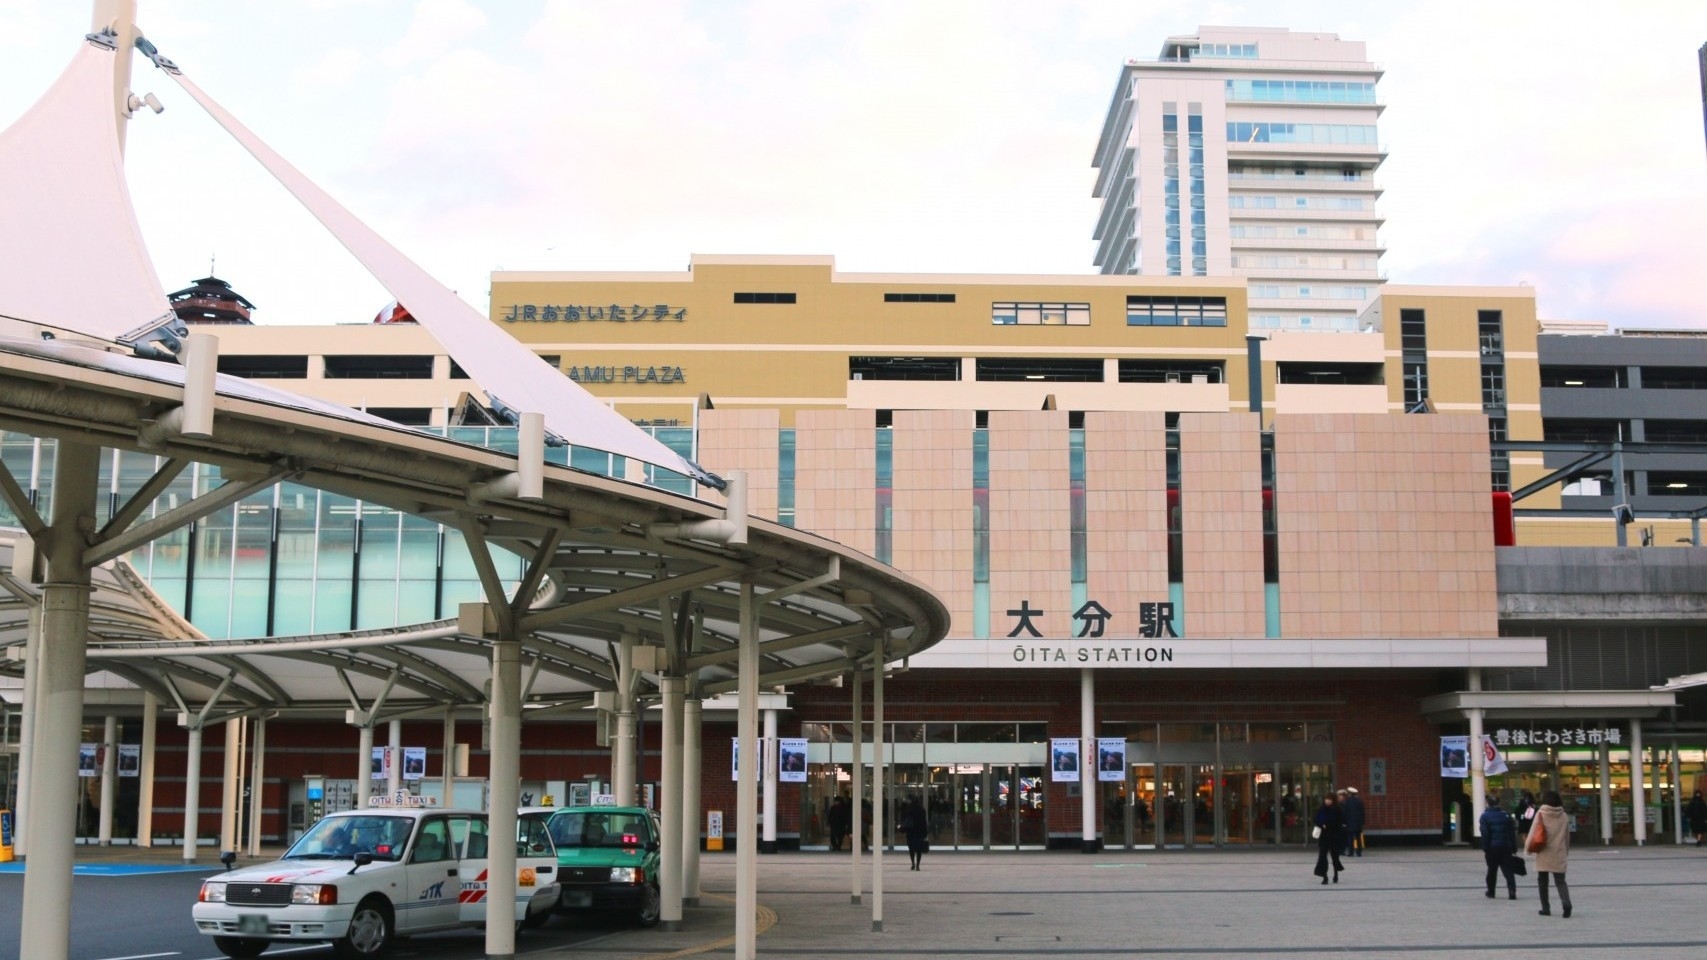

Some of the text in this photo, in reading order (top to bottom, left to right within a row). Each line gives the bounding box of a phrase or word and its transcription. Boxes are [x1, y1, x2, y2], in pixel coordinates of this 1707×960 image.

[505, 304, 687, 322] JRおおいたシティ
[569, 366, 684, 383] AMU PLAZA
[1006, 600, 1178, 638] 大分駅
[1013, 645, 1173, 662] ŌITA STATION
[1495, 728, 1622, 746] 豊後にわさき市場
